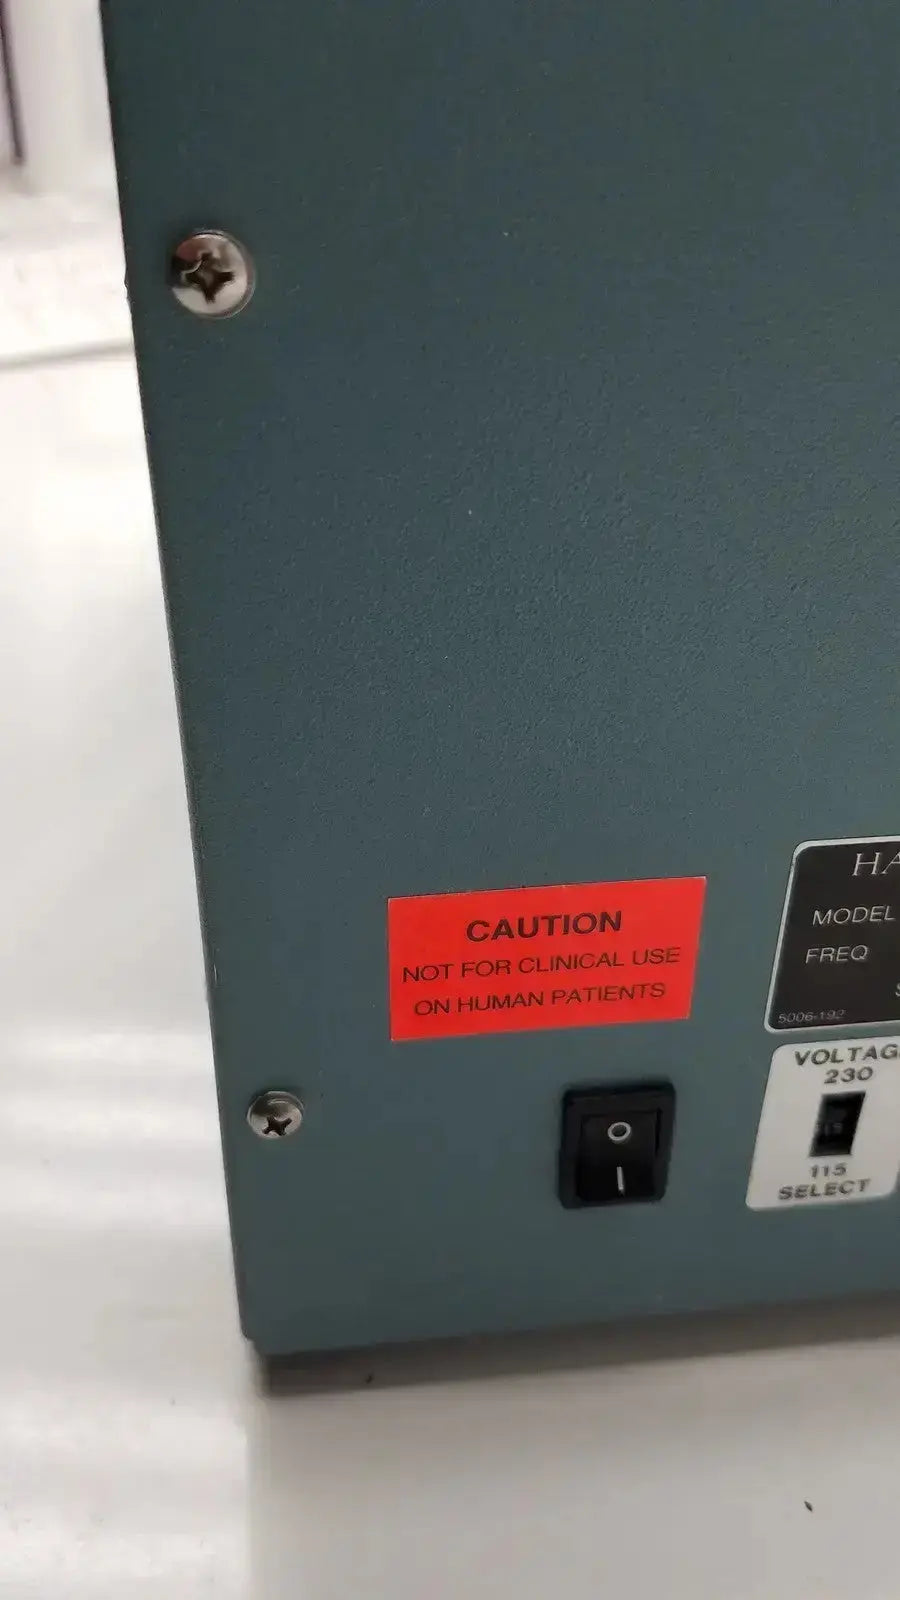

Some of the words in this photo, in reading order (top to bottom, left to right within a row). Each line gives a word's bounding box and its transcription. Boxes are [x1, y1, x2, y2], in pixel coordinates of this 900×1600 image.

[466, 910, 622, 943] CAUTION
[813, 906, 896, 926] MODEL
[402, 964, 453, 982] NOT
[461, 959, 511, 978] FOR
[518, 952, 624, 974] CLINICAL
[632, 947, 681, 966] USE
[806, 945, 869, 964] FREQ
[414, 998, 450, 1016] ON
[457, 991, 544, 1013] HUMAN
[551, 983, 666, 1004] PATIENTS
[795, 1043, 900, 1066] VOLTAG
[824, 1066, 873, 1084] 230
[812, 1163, 847, 1178] 115
[778, 1179, 871, 1200] SELECT
